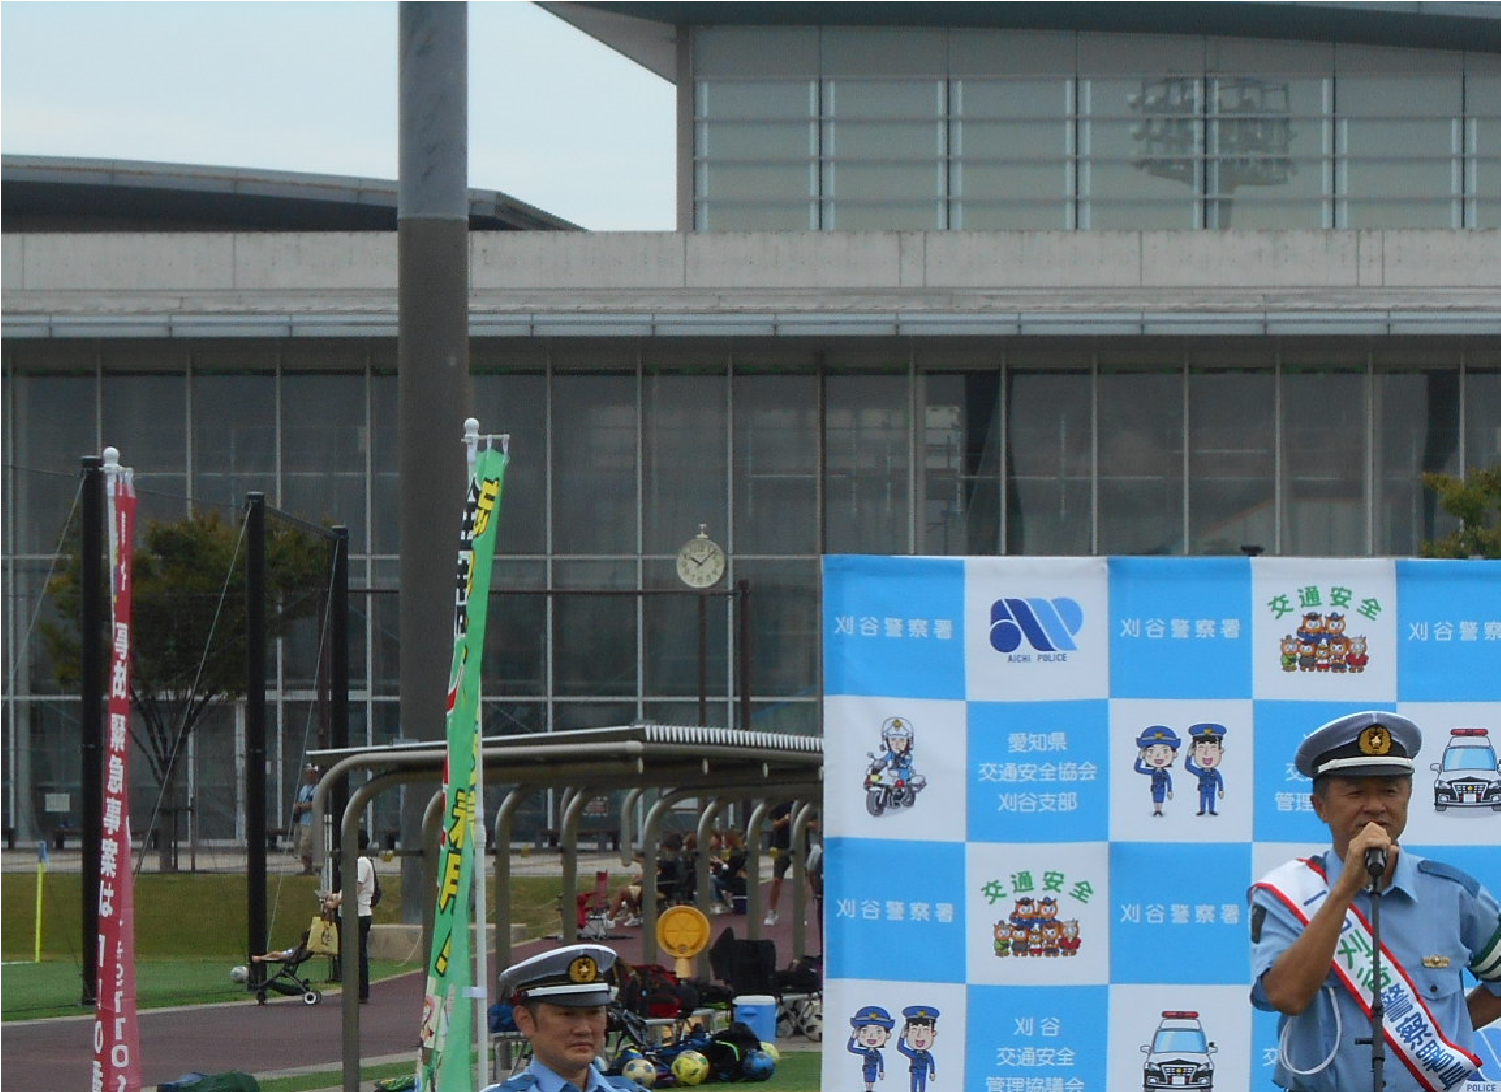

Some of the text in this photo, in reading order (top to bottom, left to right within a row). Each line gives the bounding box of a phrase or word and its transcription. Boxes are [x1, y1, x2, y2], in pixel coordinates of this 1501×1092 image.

[1268, 585, 1382, 621] 交通安全
[835, 616, 953, 640] 刈谷警察署
[1120, 618, 1240, 638] 刈谷警察署
[1006, 652, 1068, 663] AICHI POLICE
[1008, 733, 1068, 752] 愛知県
[978, 762, 1098, 782] 交通安全協会
[998, 792, 1078, 812] 刈谷支部
[982, 871, 1095, 904] 交通安全
[837, 899, 954, 922] 刈谷警察署
[1120, 904, 1240, 924] 刈谷警察署
[1303, 888, 1472, 1091] 一刈谷警察署長
[1014, 1018, 1060, 1036] 刈谷
[997, 1047, 1076, 1066] 交通安全
[1467, 1082, 1498, 1092] POLICE
